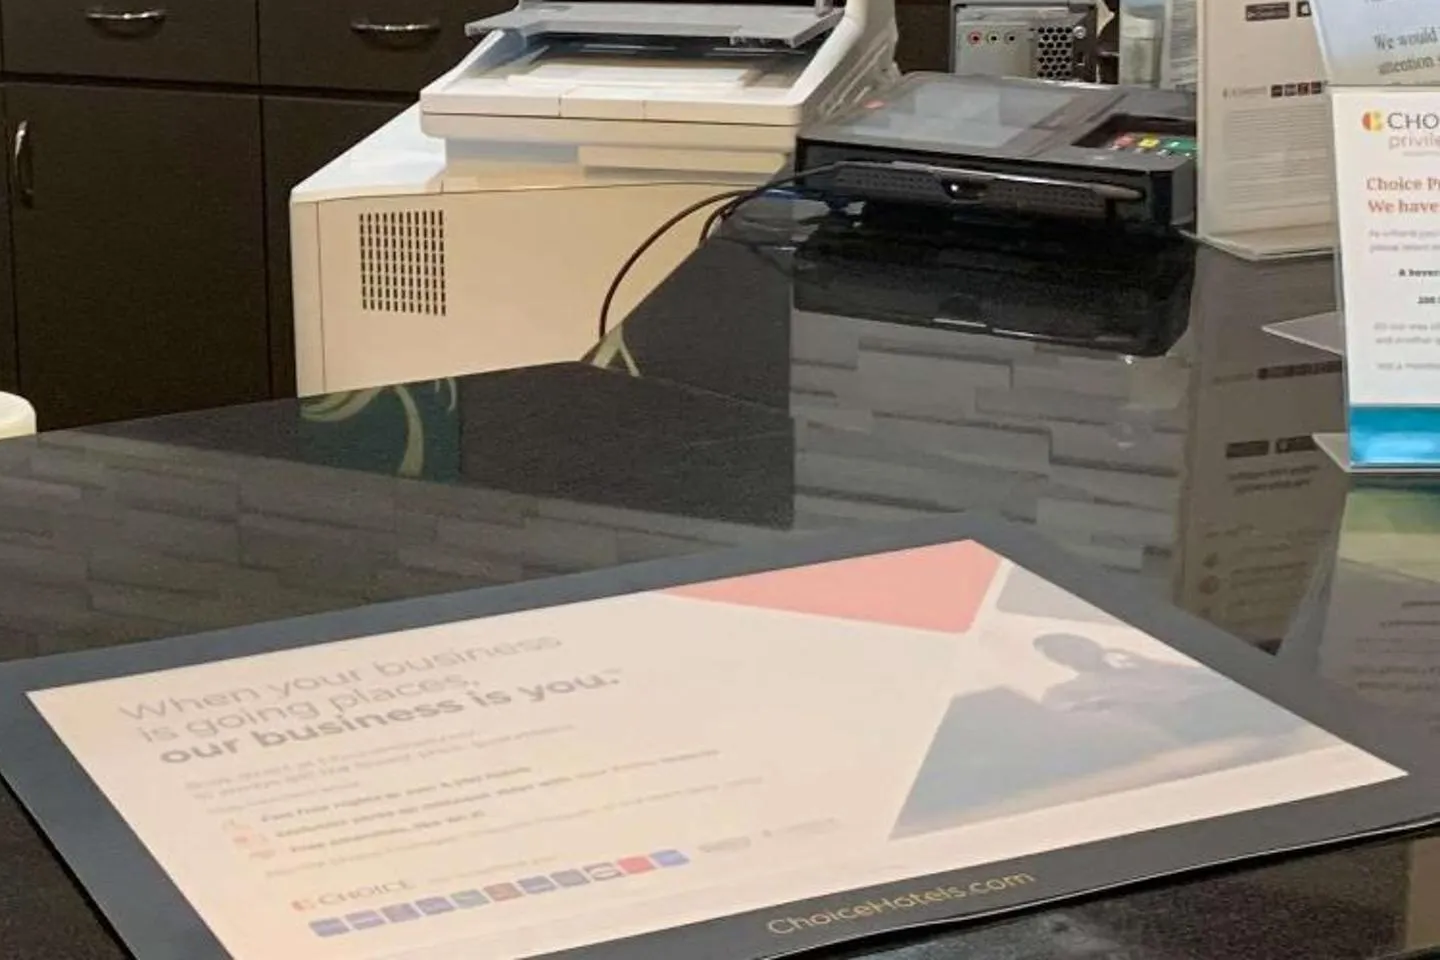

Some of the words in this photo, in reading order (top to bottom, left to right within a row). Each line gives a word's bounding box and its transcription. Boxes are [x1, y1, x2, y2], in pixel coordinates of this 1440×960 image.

[1387, 111, 1440, 130] CHO
[1366, 176, 1423, 192] Choice
[1368, 199, 1395, 213] We
[1398, 198, 1440, 213] have
[118, 687, 260, 721] When
[268, 668, 363, 698] your
[372, 636, 563, 677] business
[137, 724, 179, 744] is
[186, 700, 321, 738] going
[160, 737, 241, 764] our
[251, 698, 464, 748] business
[465, 689, 513, 708] is
[766, 870, 1036, 935] ChoiceHotels.com
